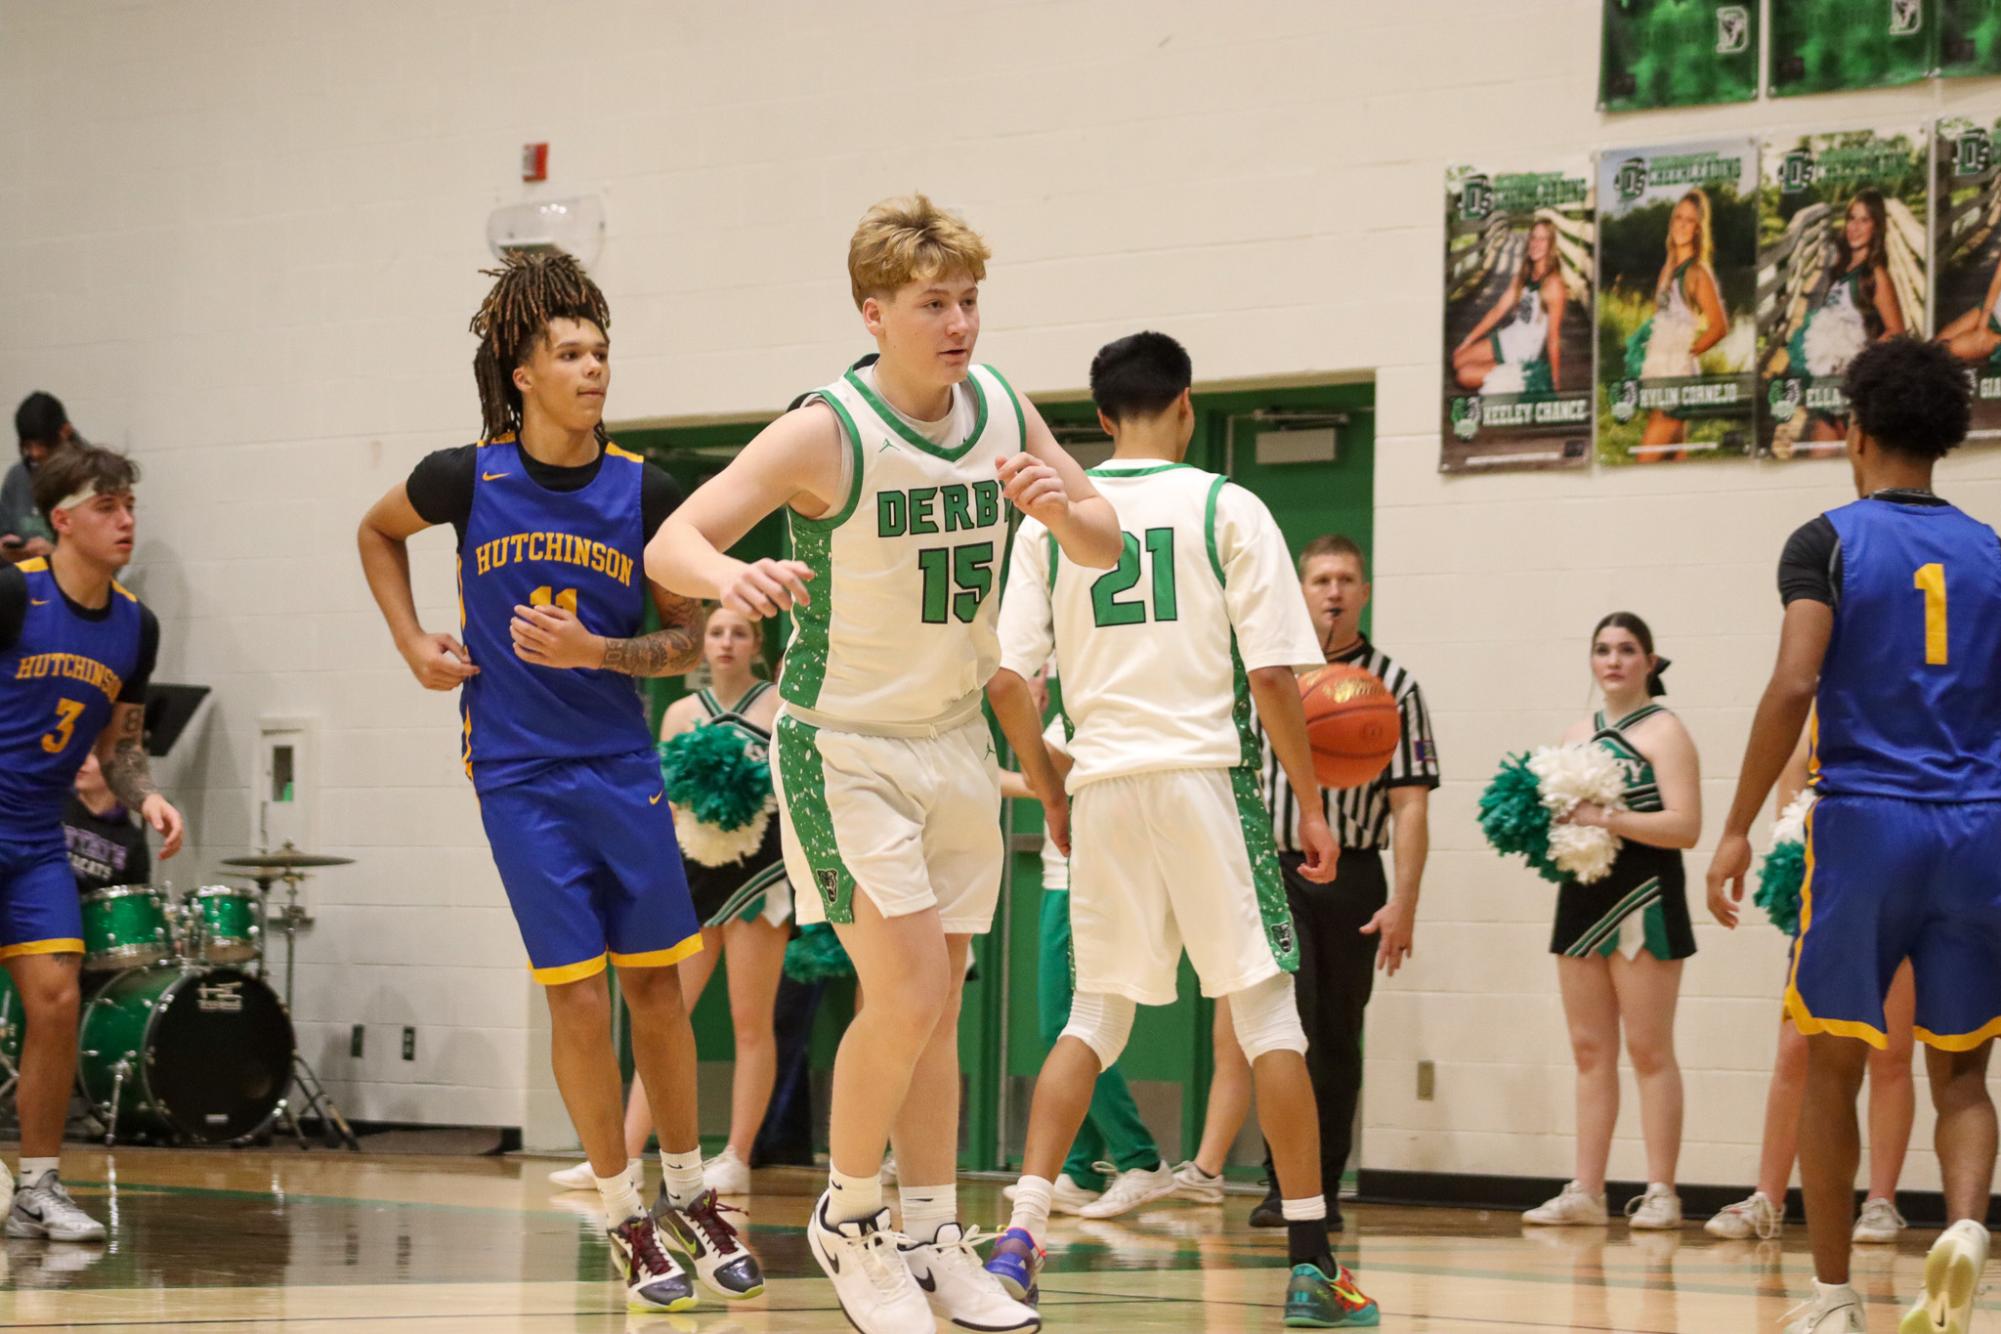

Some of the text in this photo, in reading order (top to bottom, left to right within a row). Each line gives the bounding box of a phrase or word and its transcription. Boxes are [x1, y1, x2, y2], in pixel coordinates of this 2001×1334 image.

[1482, 399, 1588, 427] KEELEY CHANCE
[475, 531, 635, 587] HUTCHINSON
[918, 541, 994, 625] 15
[1089, 526, 1178, 628] 21
[1913, 562, 1949, 666] 1
[41, 697, 86, 754] 3
